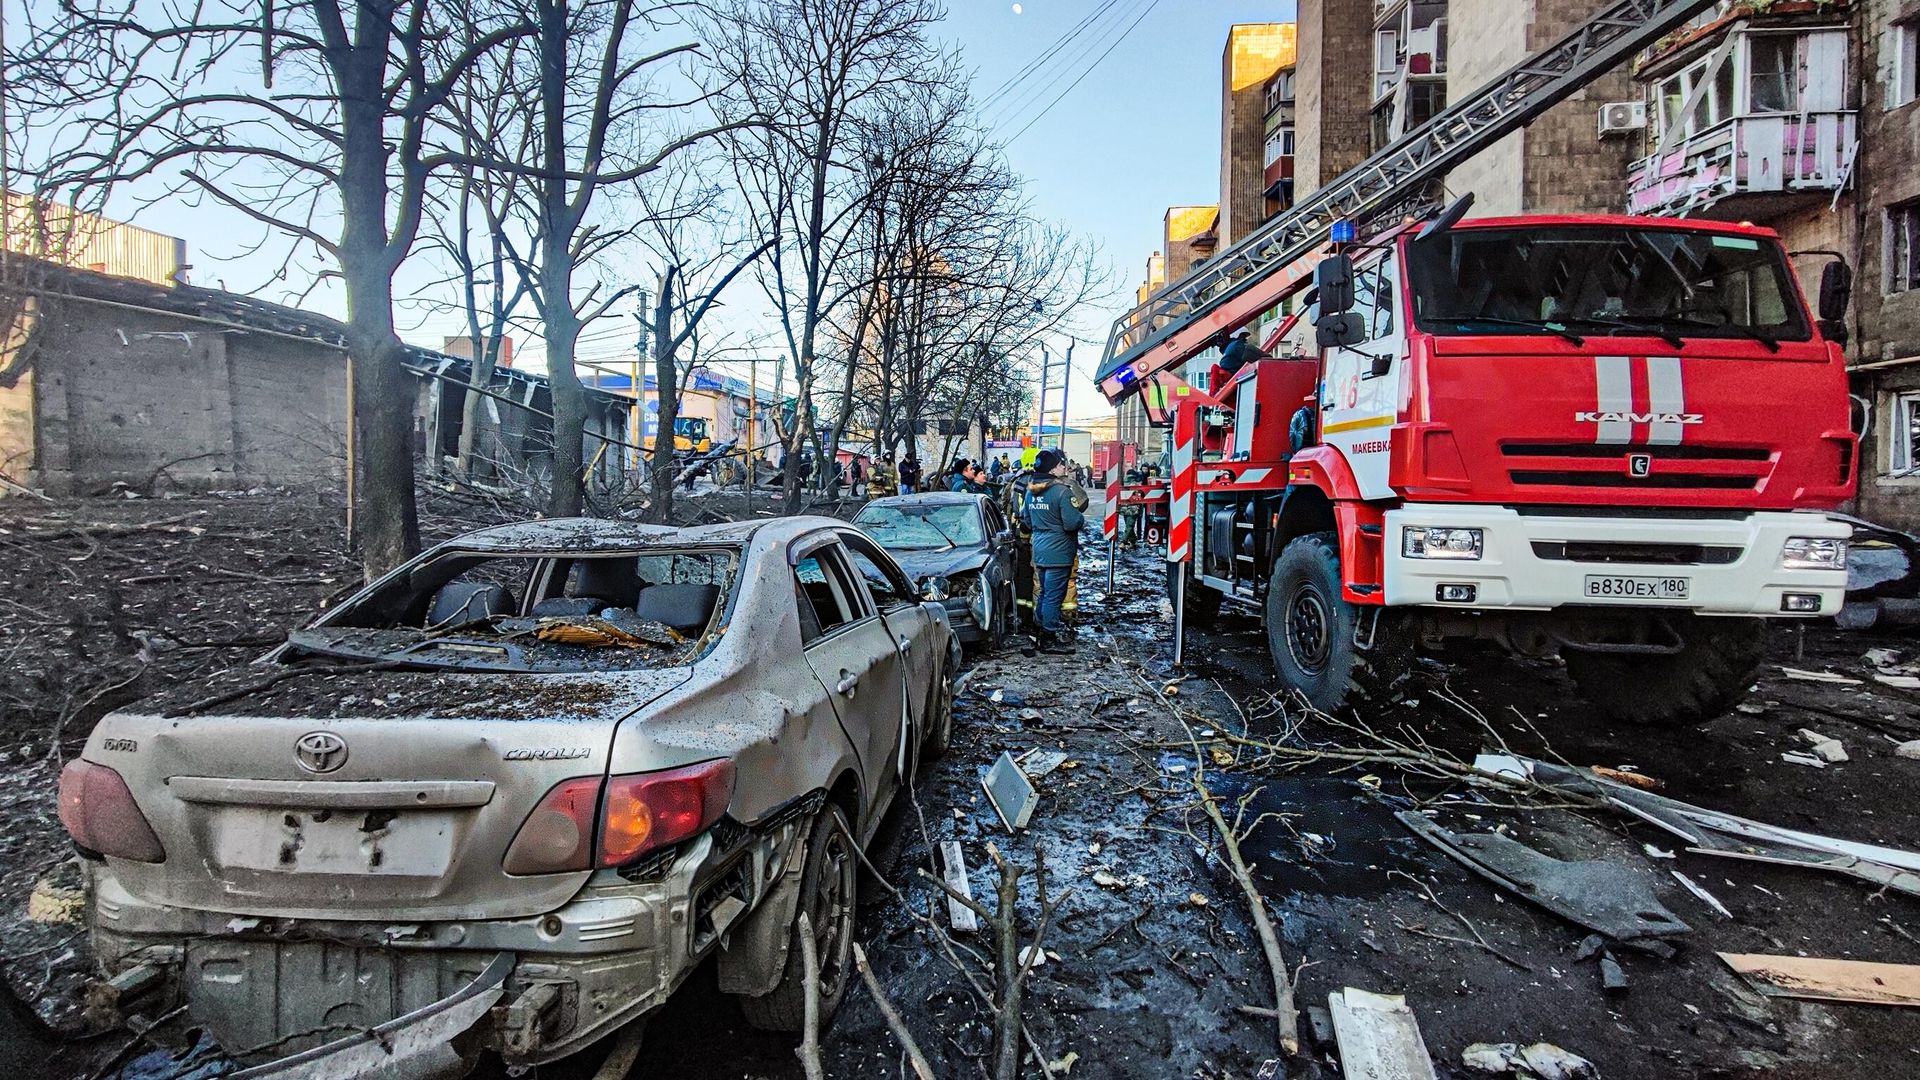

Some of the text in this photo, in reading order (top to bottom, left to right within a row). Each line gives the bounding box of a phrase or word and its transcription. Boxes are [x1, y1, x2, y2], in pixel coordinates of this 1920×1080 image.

[1339, 375, 1358, 410] 16
[1660, 579, 1685, 593] 180
[503, 747, 591, 761] COROLLA
